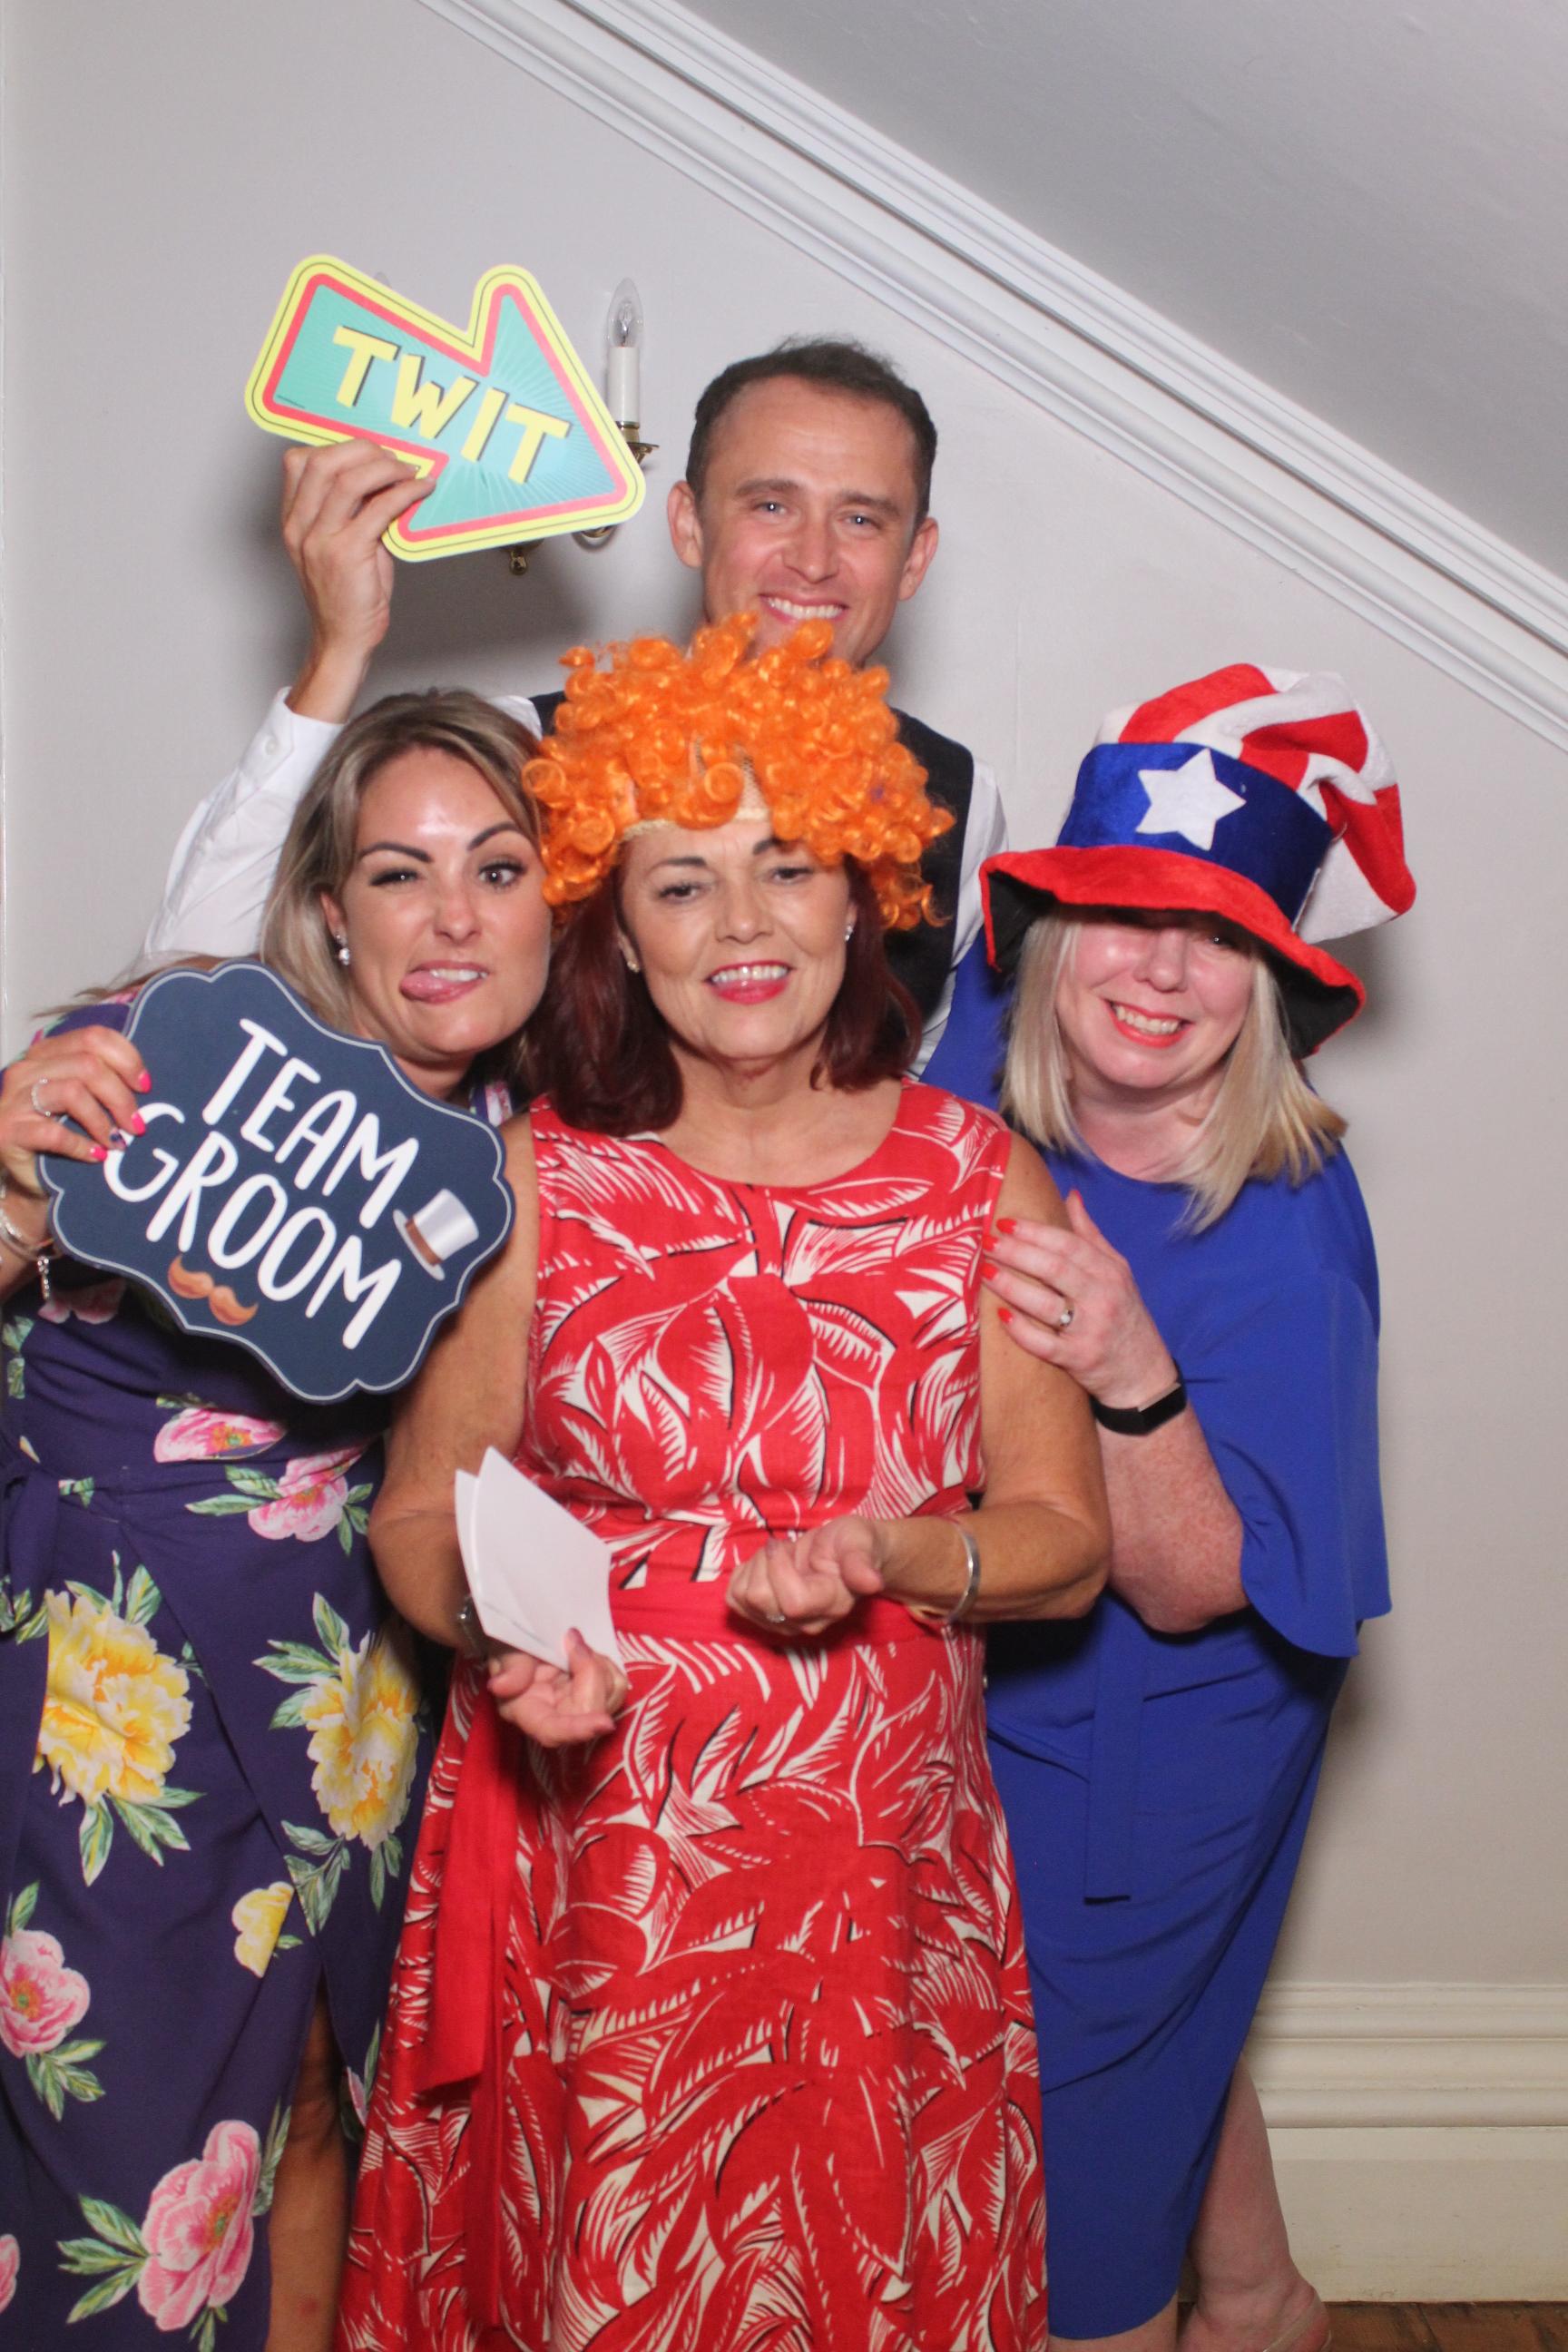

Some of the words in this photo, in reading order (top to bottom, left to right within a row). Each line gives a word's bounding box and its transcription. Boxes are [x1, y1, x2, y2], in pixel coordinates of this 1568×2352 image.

[333, 326, 572, 485] TWIT
[104, 1102, 402, 1349] GROOM
[202, 1018, 418, 1229] TEAM
